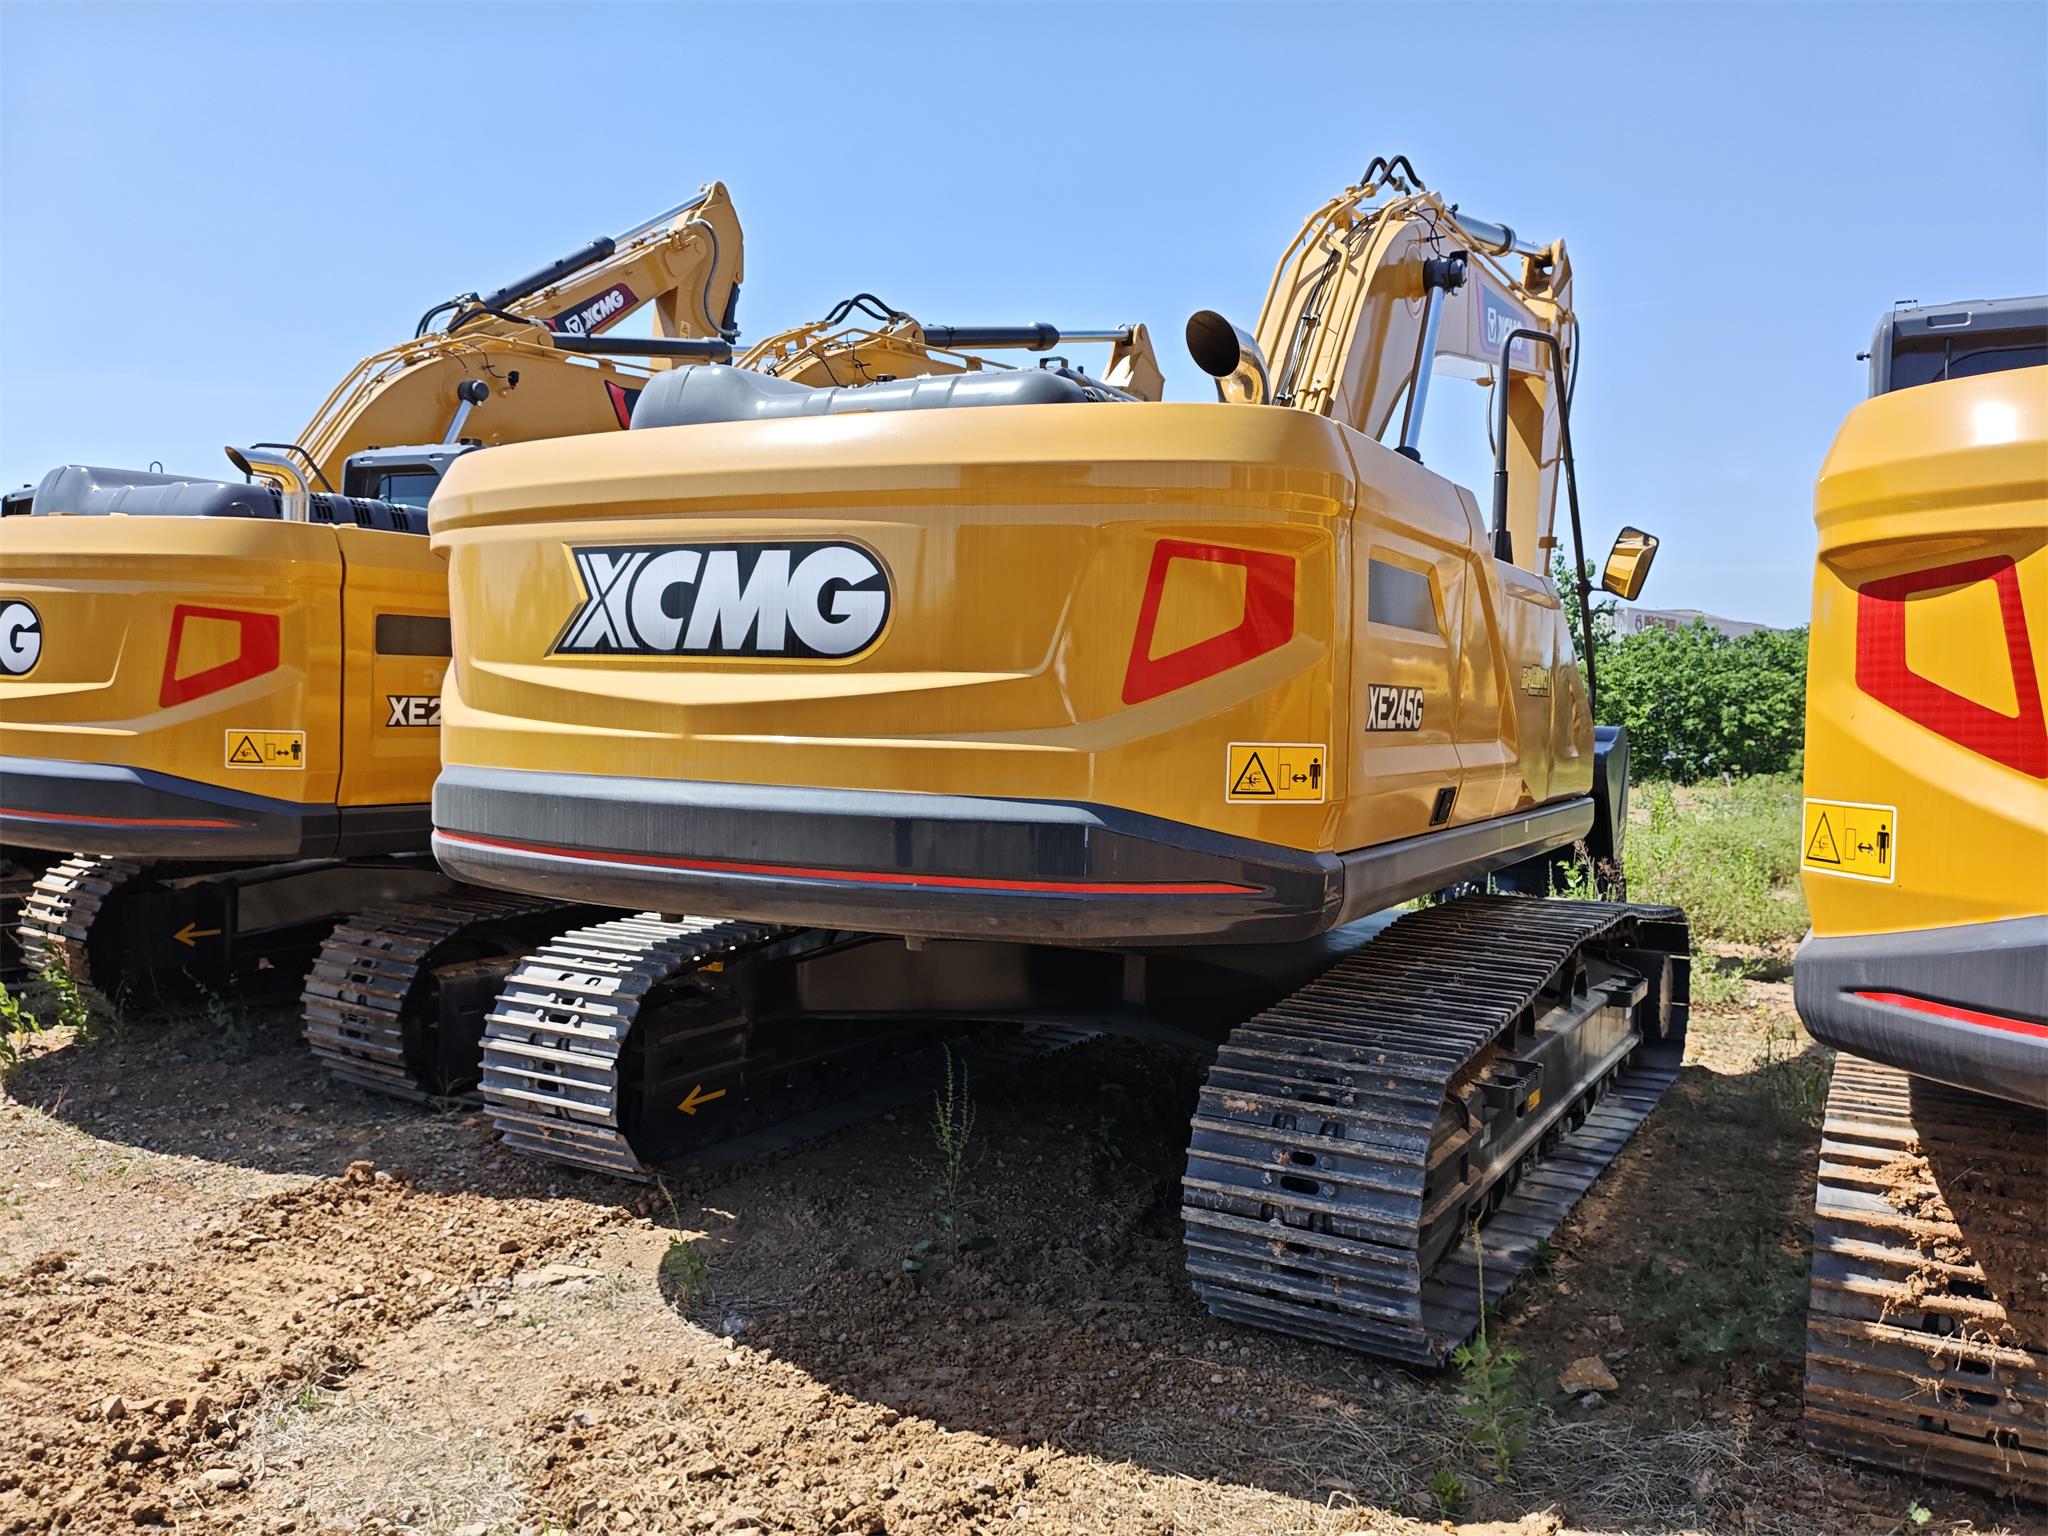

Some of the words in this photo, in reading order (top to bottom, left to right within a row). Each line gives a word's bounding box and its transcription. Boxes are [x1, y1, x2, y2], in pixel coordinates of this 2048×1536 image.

[582, 290, 624, 328] XCMG
[563, 546, 885, 654] XCMG
[1366, 686, 1423, 729] XE245G
